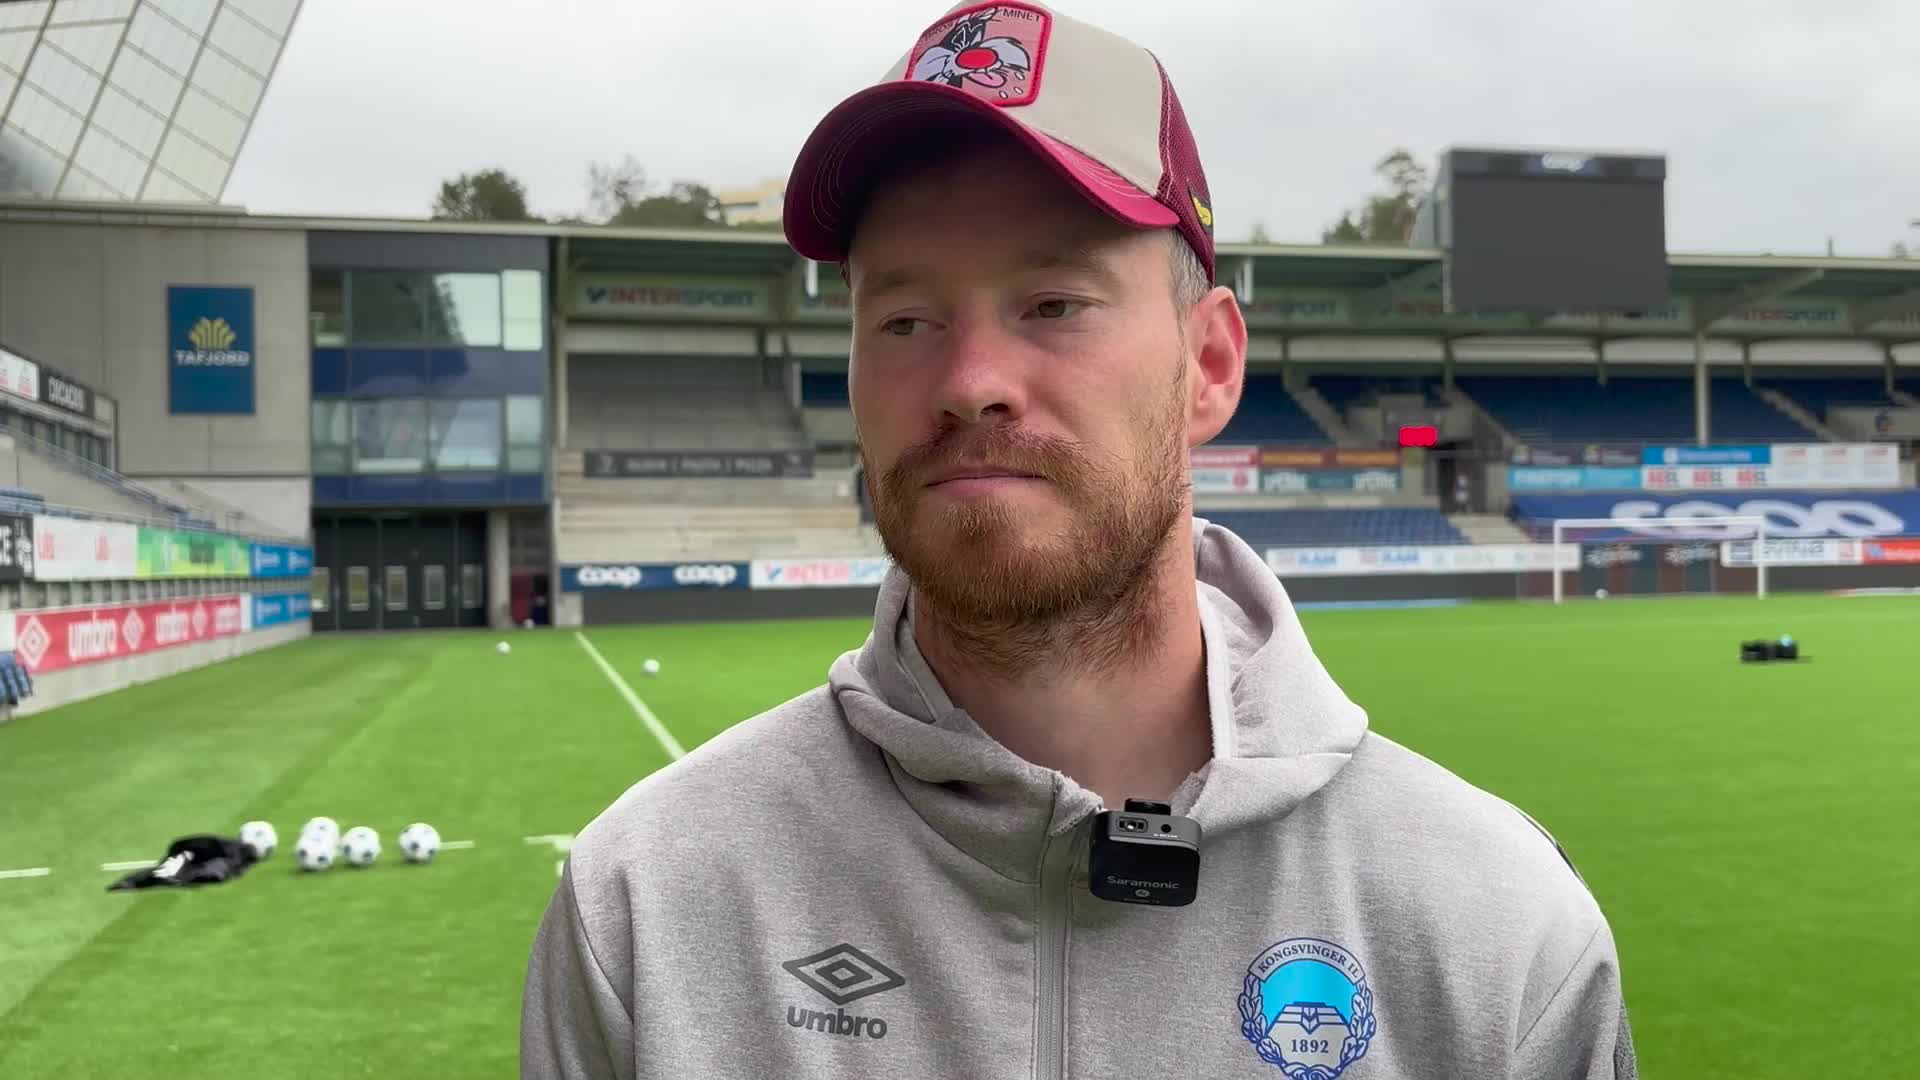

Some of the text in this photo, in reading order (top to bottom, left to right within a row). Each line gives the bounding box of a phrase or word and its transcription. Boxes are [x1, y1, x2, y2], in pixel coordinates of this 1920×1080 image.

[1003, 8, 1040, 22] MINET
[175, 350, 250, 367] TAFJORD
[1106, 875, 1180, 890] Saramonic
[1257, 943, 1362, 979] KONGSVINGER IL
[787, 1005, 888, 1039] umbro
[1290, 1038, 1330, 1054] 1892
